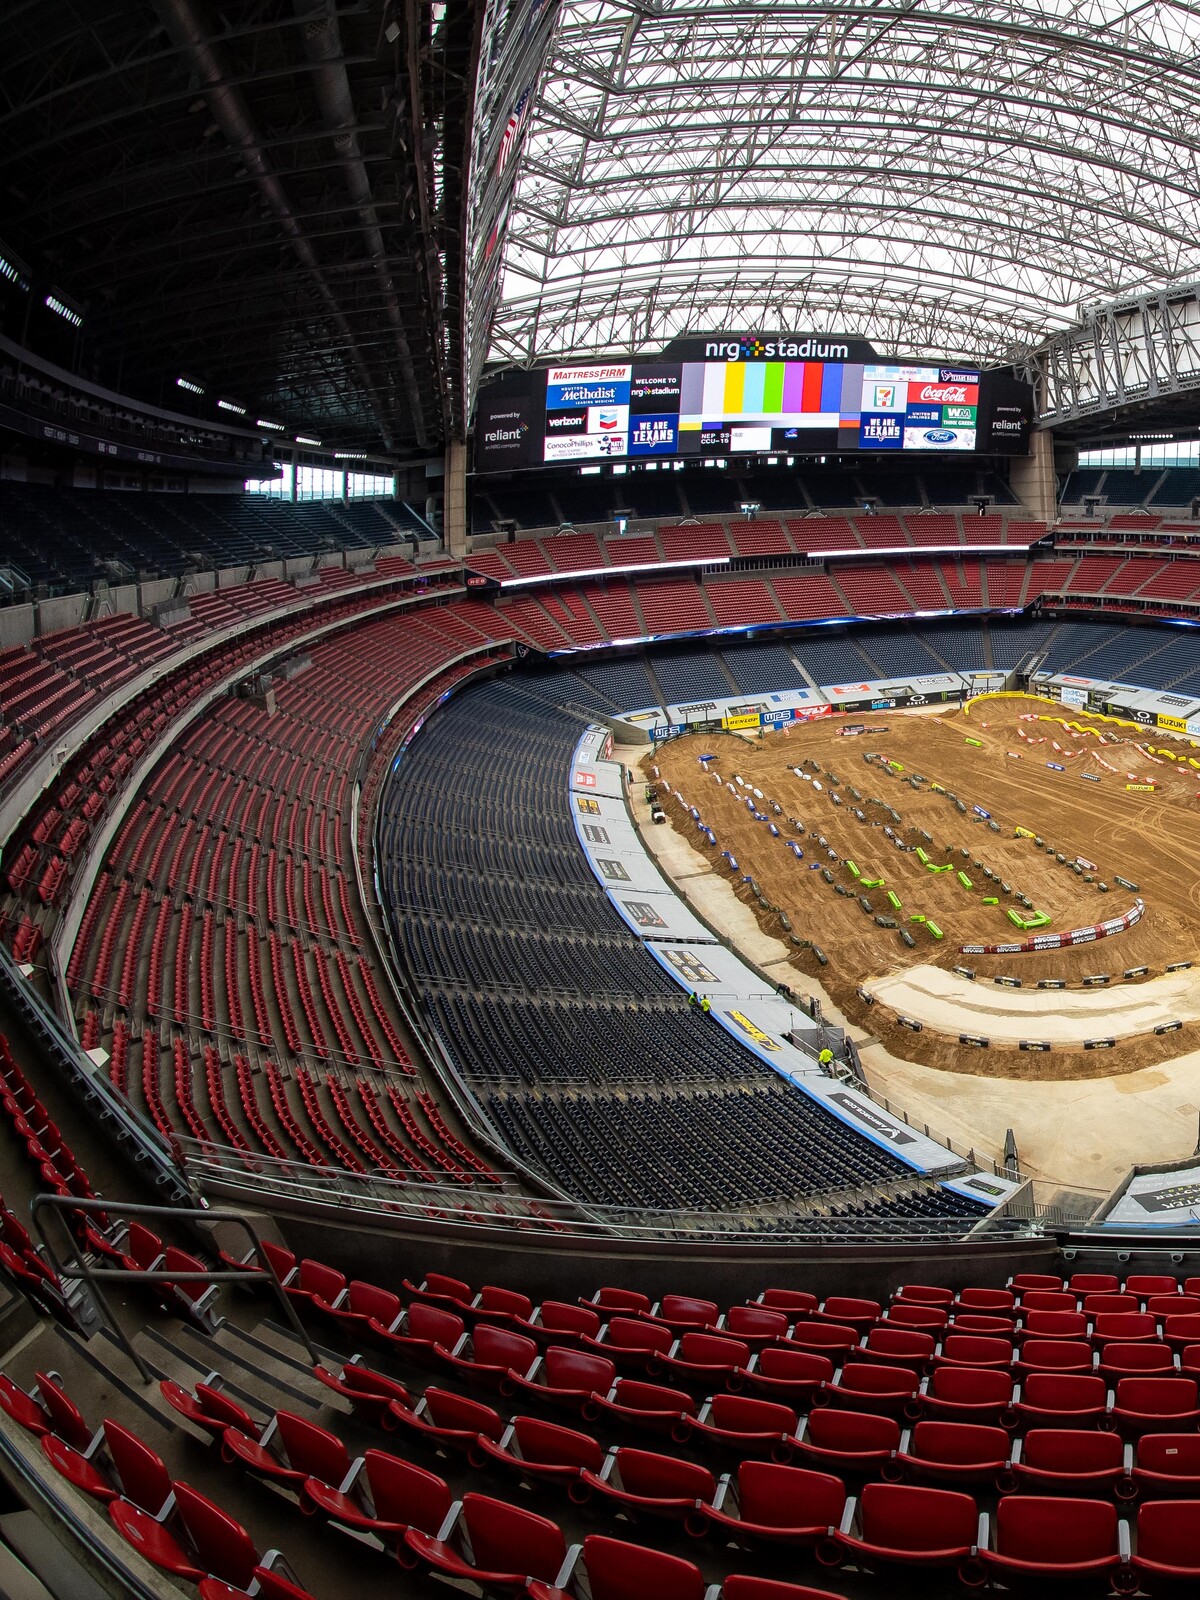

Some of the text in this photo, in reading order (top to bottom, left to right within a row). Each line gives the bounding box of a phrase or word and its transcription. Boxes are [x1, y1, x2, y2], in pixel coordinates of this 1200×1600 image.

[705, 339, 849, 361] nrg stadium
[560, 388, 616, 401] Methodist
[549, 417, 582, 426] verizon
[639, 421, 668, 430] WE ARE
[870, 418, 896, 426] WE ARE
[992, 420, 1022, 430] reliant
[485, 429, 521, 441] reliant
[633, 430, 674, 442] TEXANS
[864, 426, 900, 436] TEXANS
[730, 717, 758, 725] DUNLOP
[764, 710, 791, 723] WPS
[1159, 718, 1187, 730] SUZUKI
[842, 1098, 888, 1128] AIRFORCE.COM
